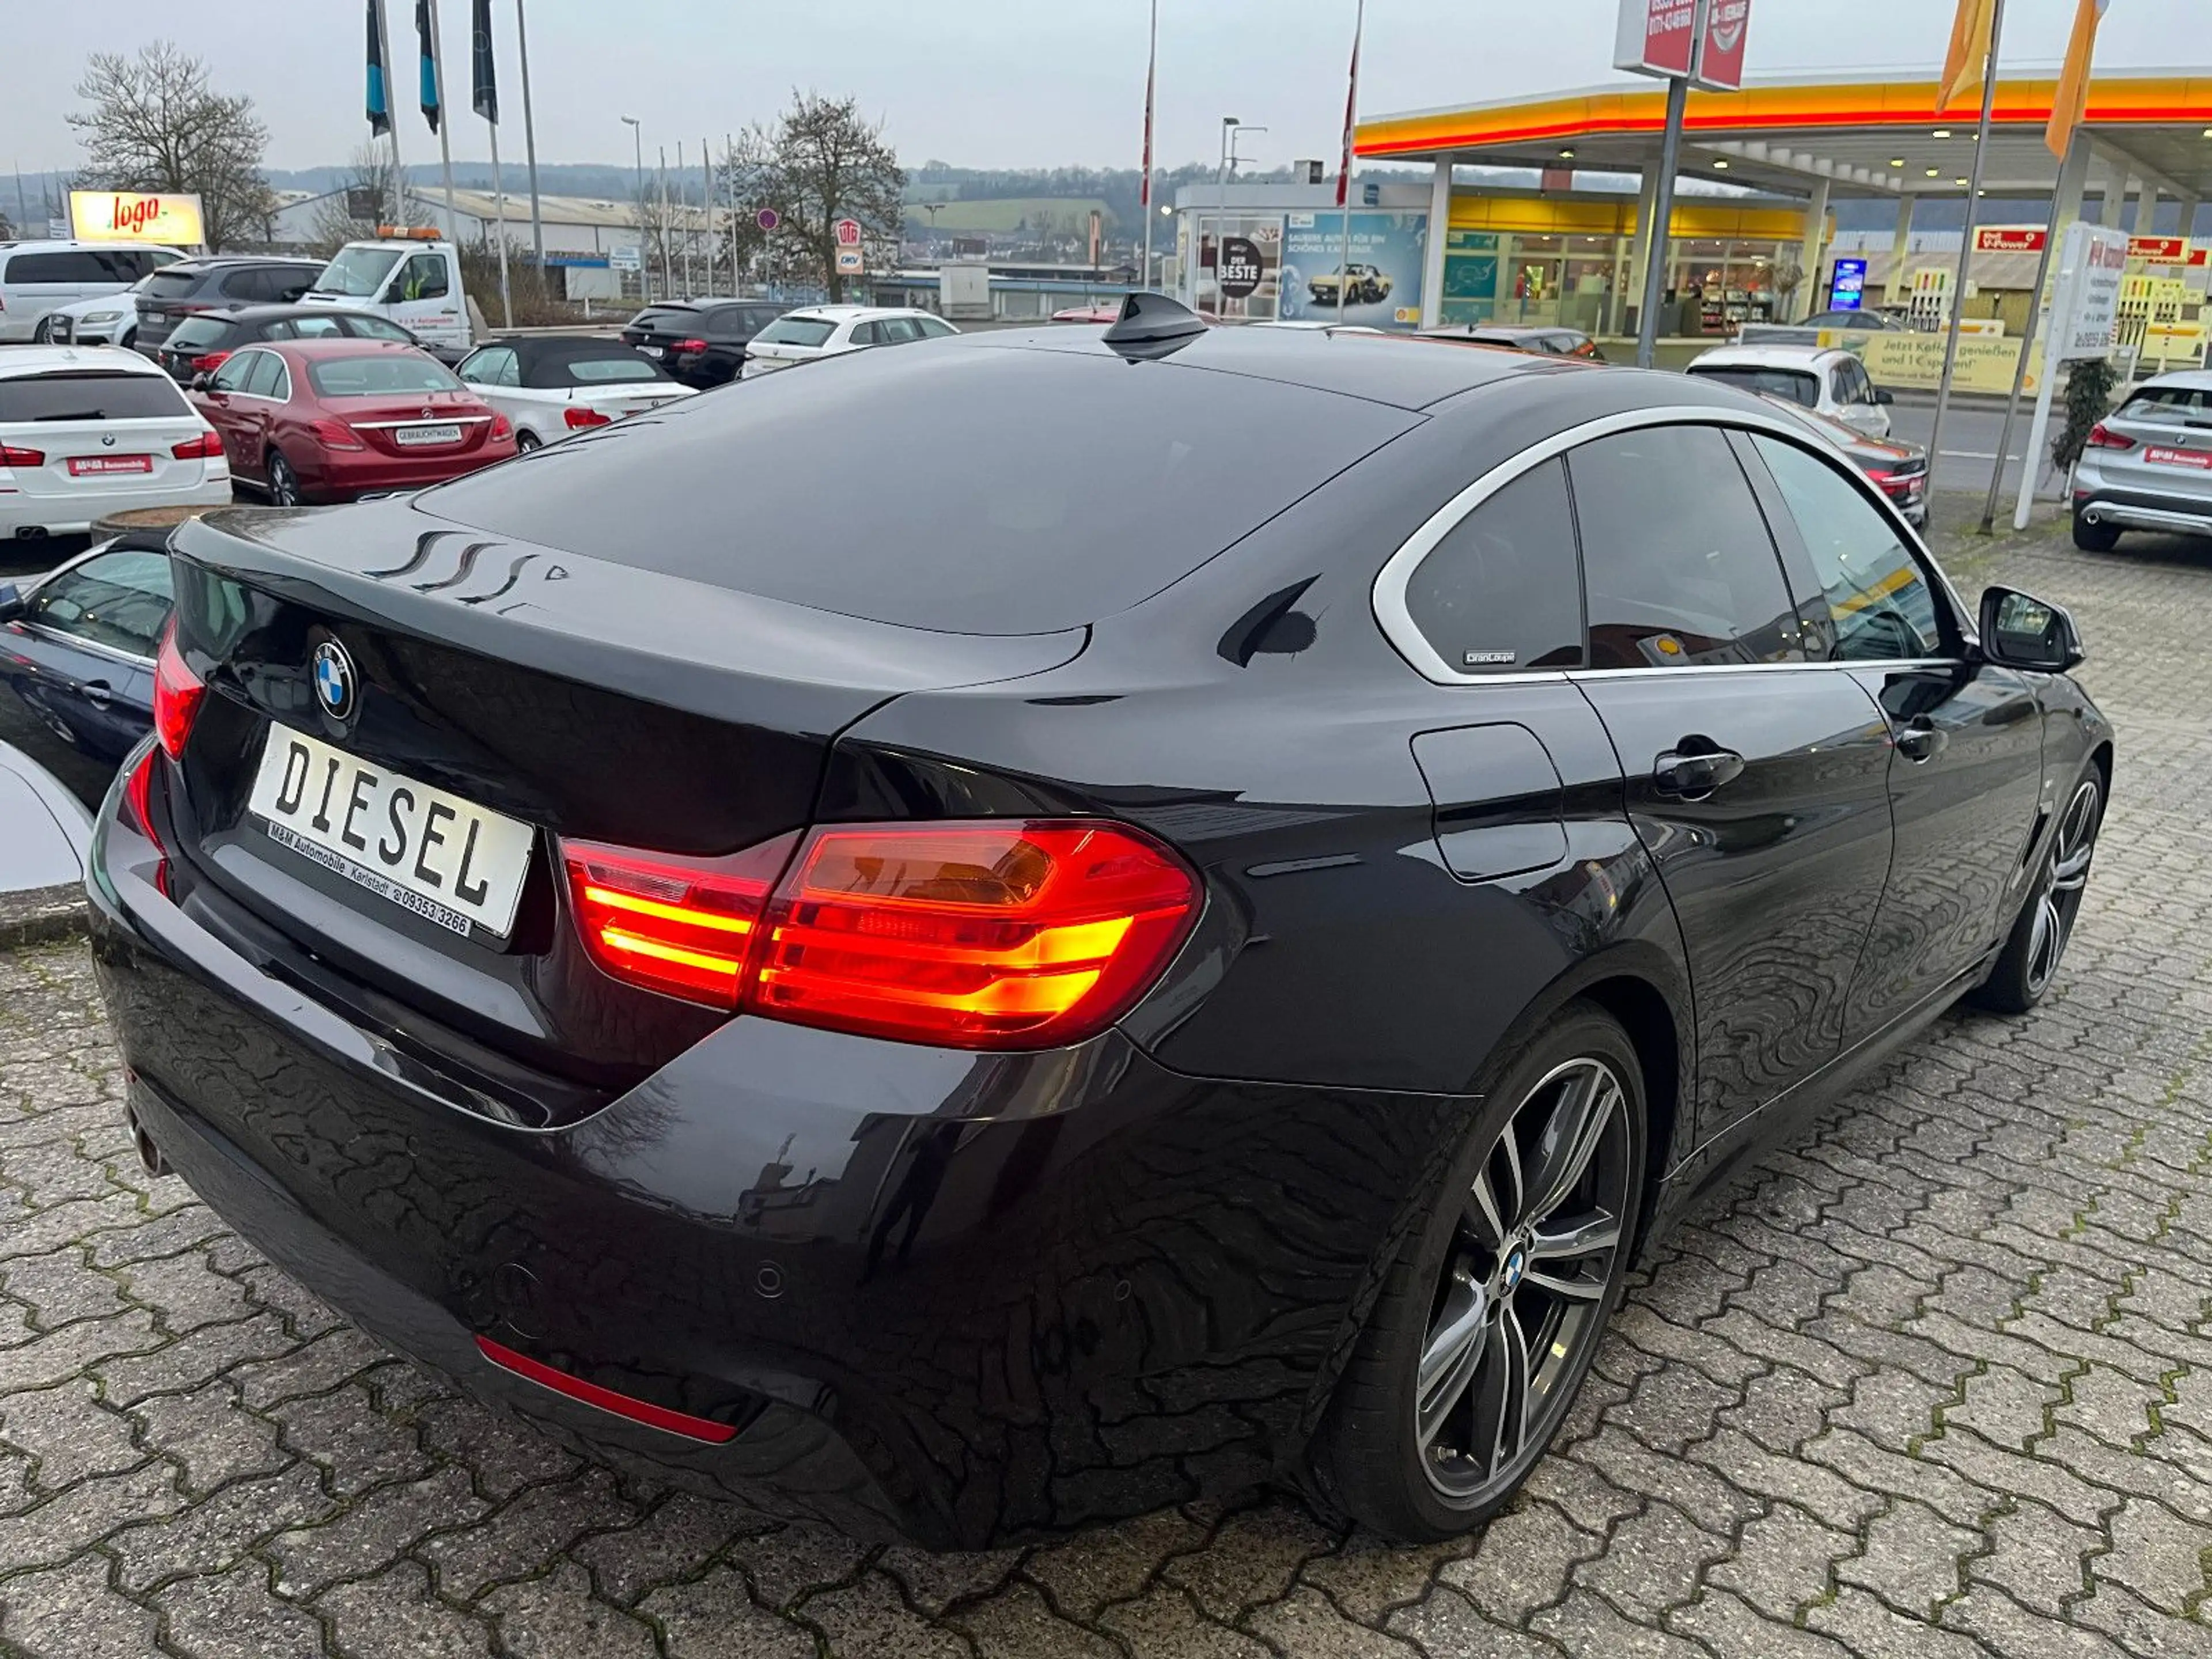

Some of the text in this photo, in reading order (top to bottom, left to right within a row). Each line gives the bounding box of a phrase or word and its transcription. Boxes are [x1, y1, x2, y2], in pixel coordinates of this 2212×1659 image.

[113, 196, 159, 233] logo
[1230, 256, 1246, 265] DER
[1221, 265, 1257, 279] BESTE
[1883, 339, 2016, 358] Jetzt Kaffe genießen
[1881, 353, 1905, 365] und
[275, 740, 488, 907] DIESEL
[271, 824, 468, 933] M&M Automobile Karlstadt 09353/3266
